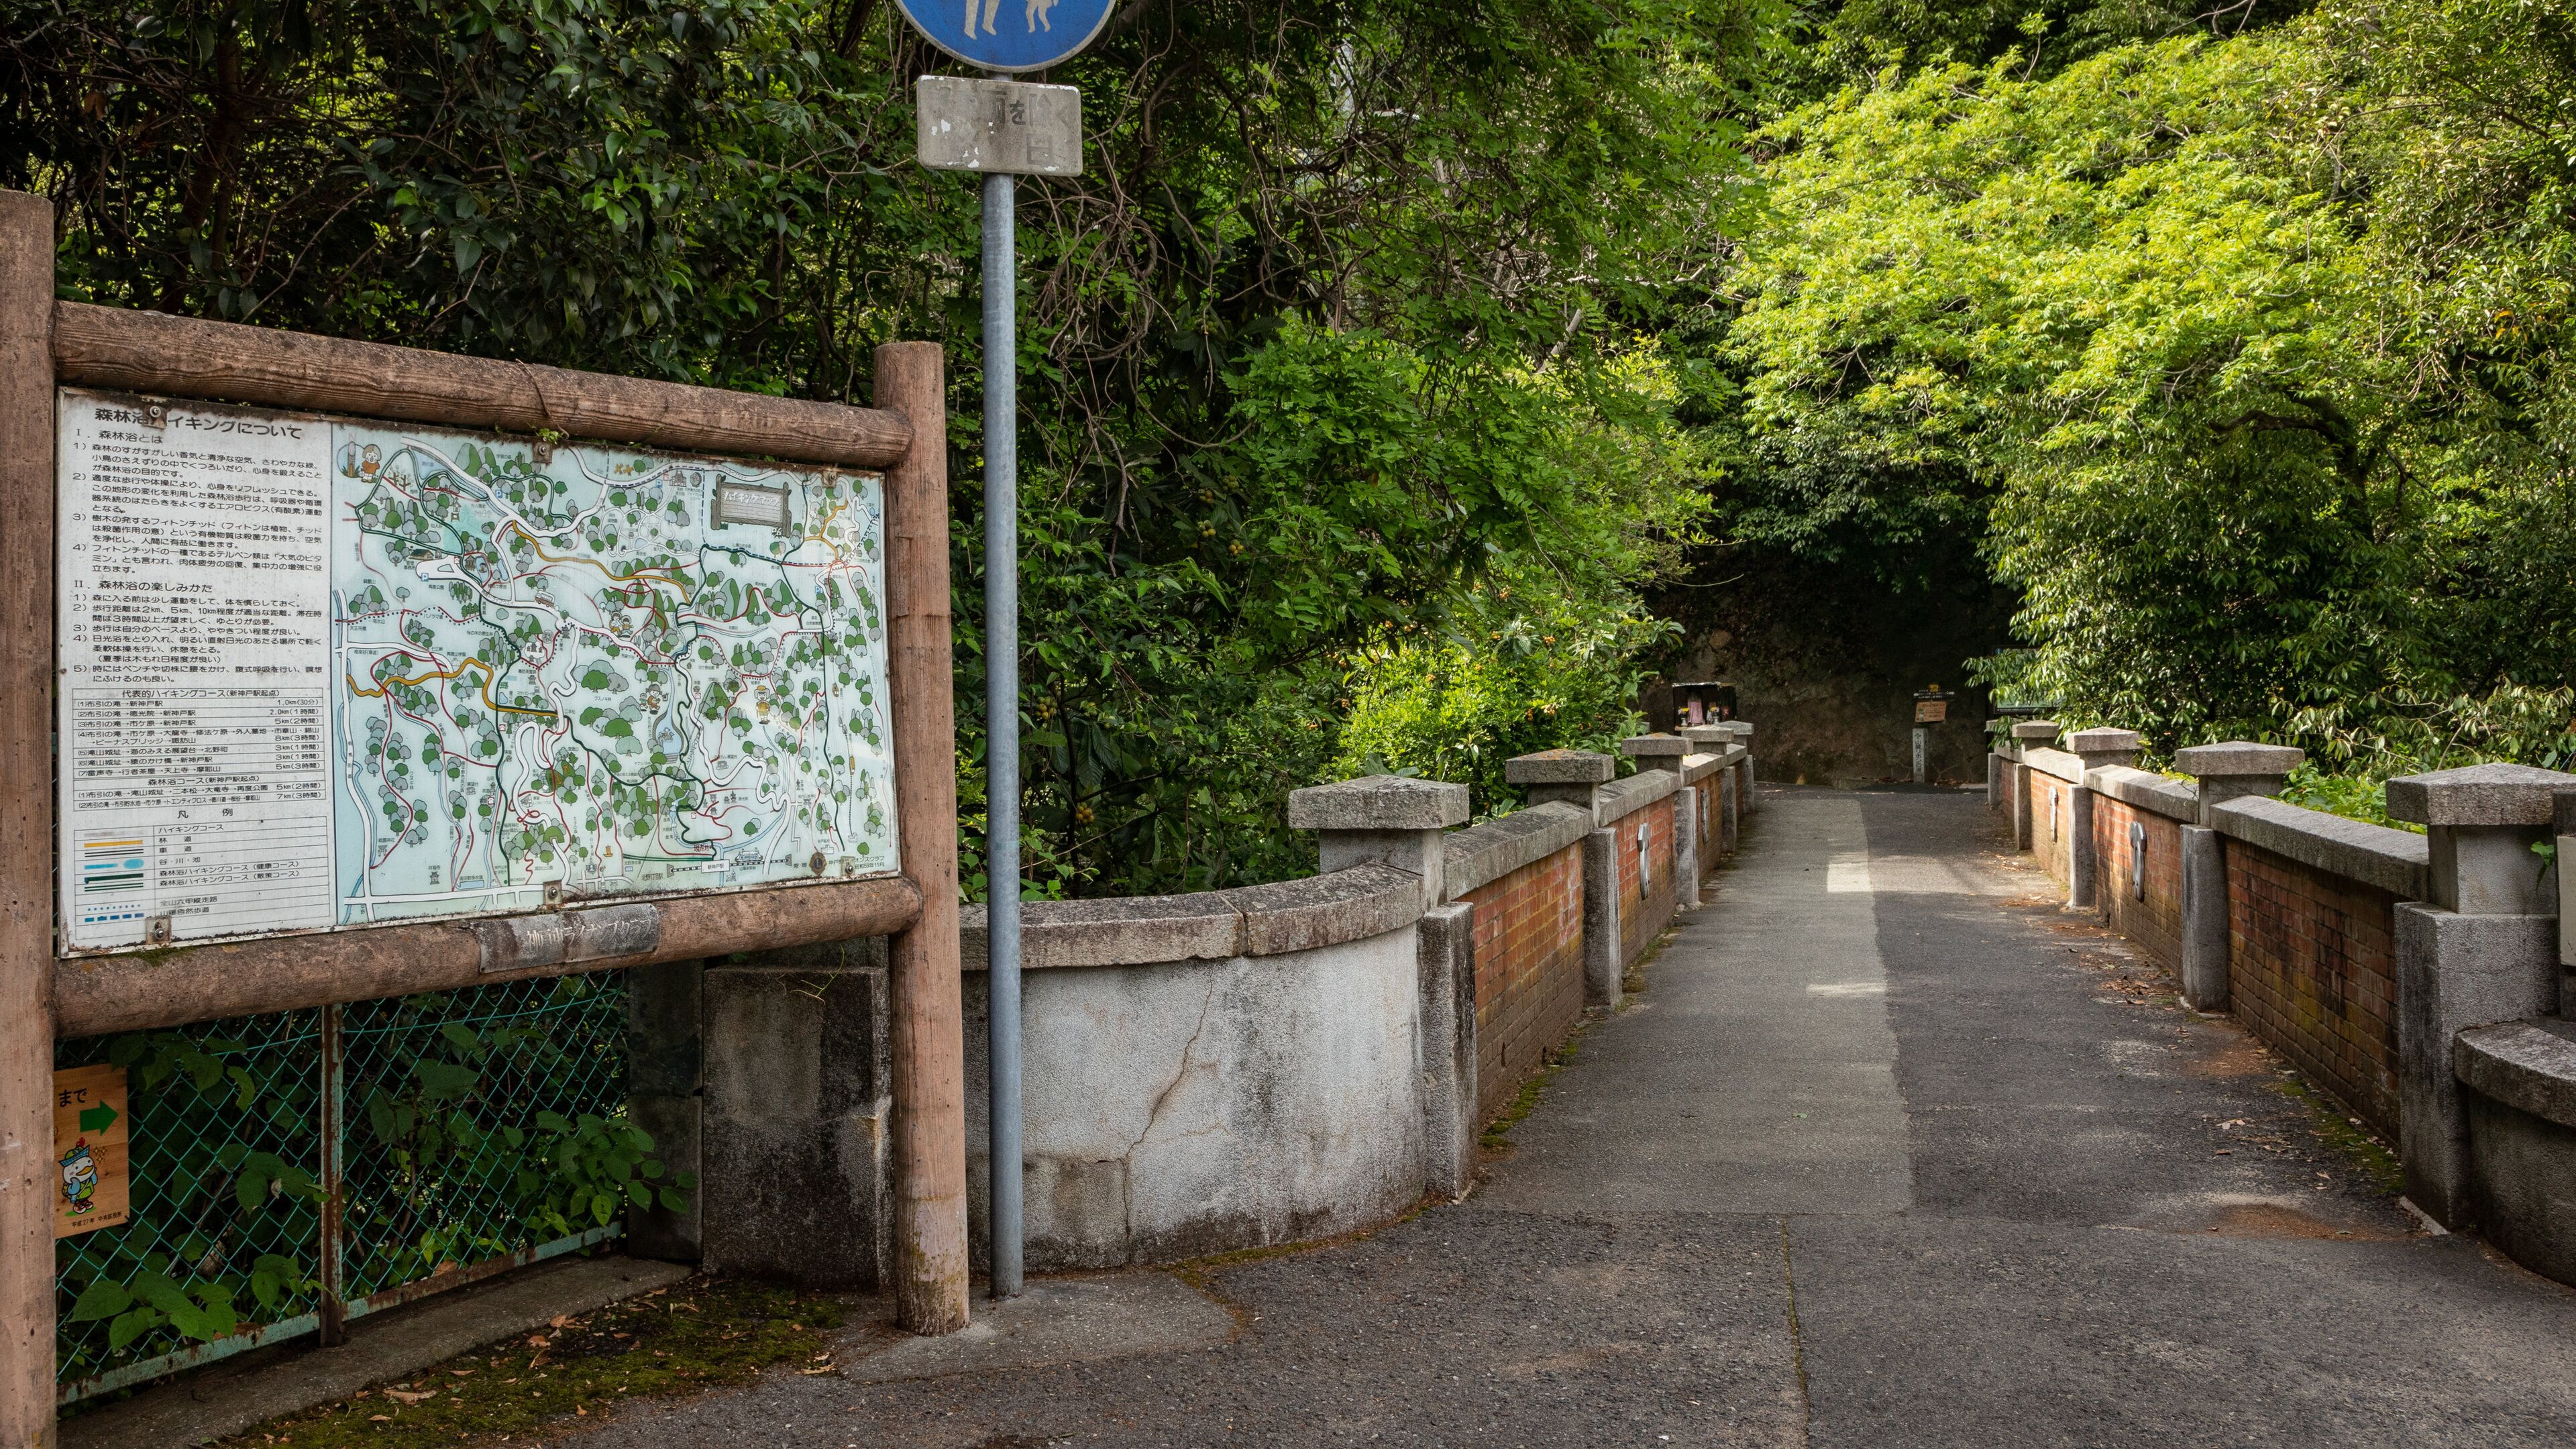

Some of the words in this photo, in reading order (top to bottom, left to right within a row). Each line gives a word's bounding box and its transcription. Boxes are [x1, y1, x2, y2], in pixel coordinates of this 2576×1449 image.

[99, 430, 164, 444] 森林浴とは
[92, 443, 318, 469] 森林のすがすがしい香気と清浄な空気、さわやかな緑、
[92, 454, 323, 479] 小鳥のさえずりの中でくつろいだり、心身を鍛えること
[93, 465, 183, 478] が森林浴の目的です。
[92, 474, 318, 497] 適度な歩行や体操により、心身をリフレッシュできる。
[93, 484, 323, 507] この地形の変化を利用した森林浴歩行は、呼吸器や循環
[724, 490, 780, 507] ハイキングマップ
[92, 494, 323, 517] 器系統のはたらきをよくするエアロビクス(有酸素)運動
[93, 535, 239, 549] を浄化し、人間に有益に働きます。
[93, 554, 323, 572] ミン」とも言われ、肉体疲労の回復、集中力の増強に役
[93, 565, 136, 574] 立ちます。
[99, 580, 213, 594] 森林浴の楽しみかた
[93, 594, 301, 608] 森に入る前は少し運動をして、体を慣らしておく。
[93, 614, 275, 627] 間は3時間以上が望ましく、ゆとりが必要。
[93, 625, 301, 636] 歩行は自分のペースより、ややきつい程度が良い。
[93, 635, 322, 645] 日光浴をとり入れ、明るい直射日光のあたる場所で軽く
[93, 645, 221, 654] 柔軟体操を行い、休憩をとる。
[122, 690, 280, 698] 代表的ハイキングコース(新神戸駅起点)
[148, 775, 260, 786] 森林浴コース(新神戸駅起点)
[158, 824, 224, 834] ハイキングコース
[58, 1087, 87, 1108] まで
